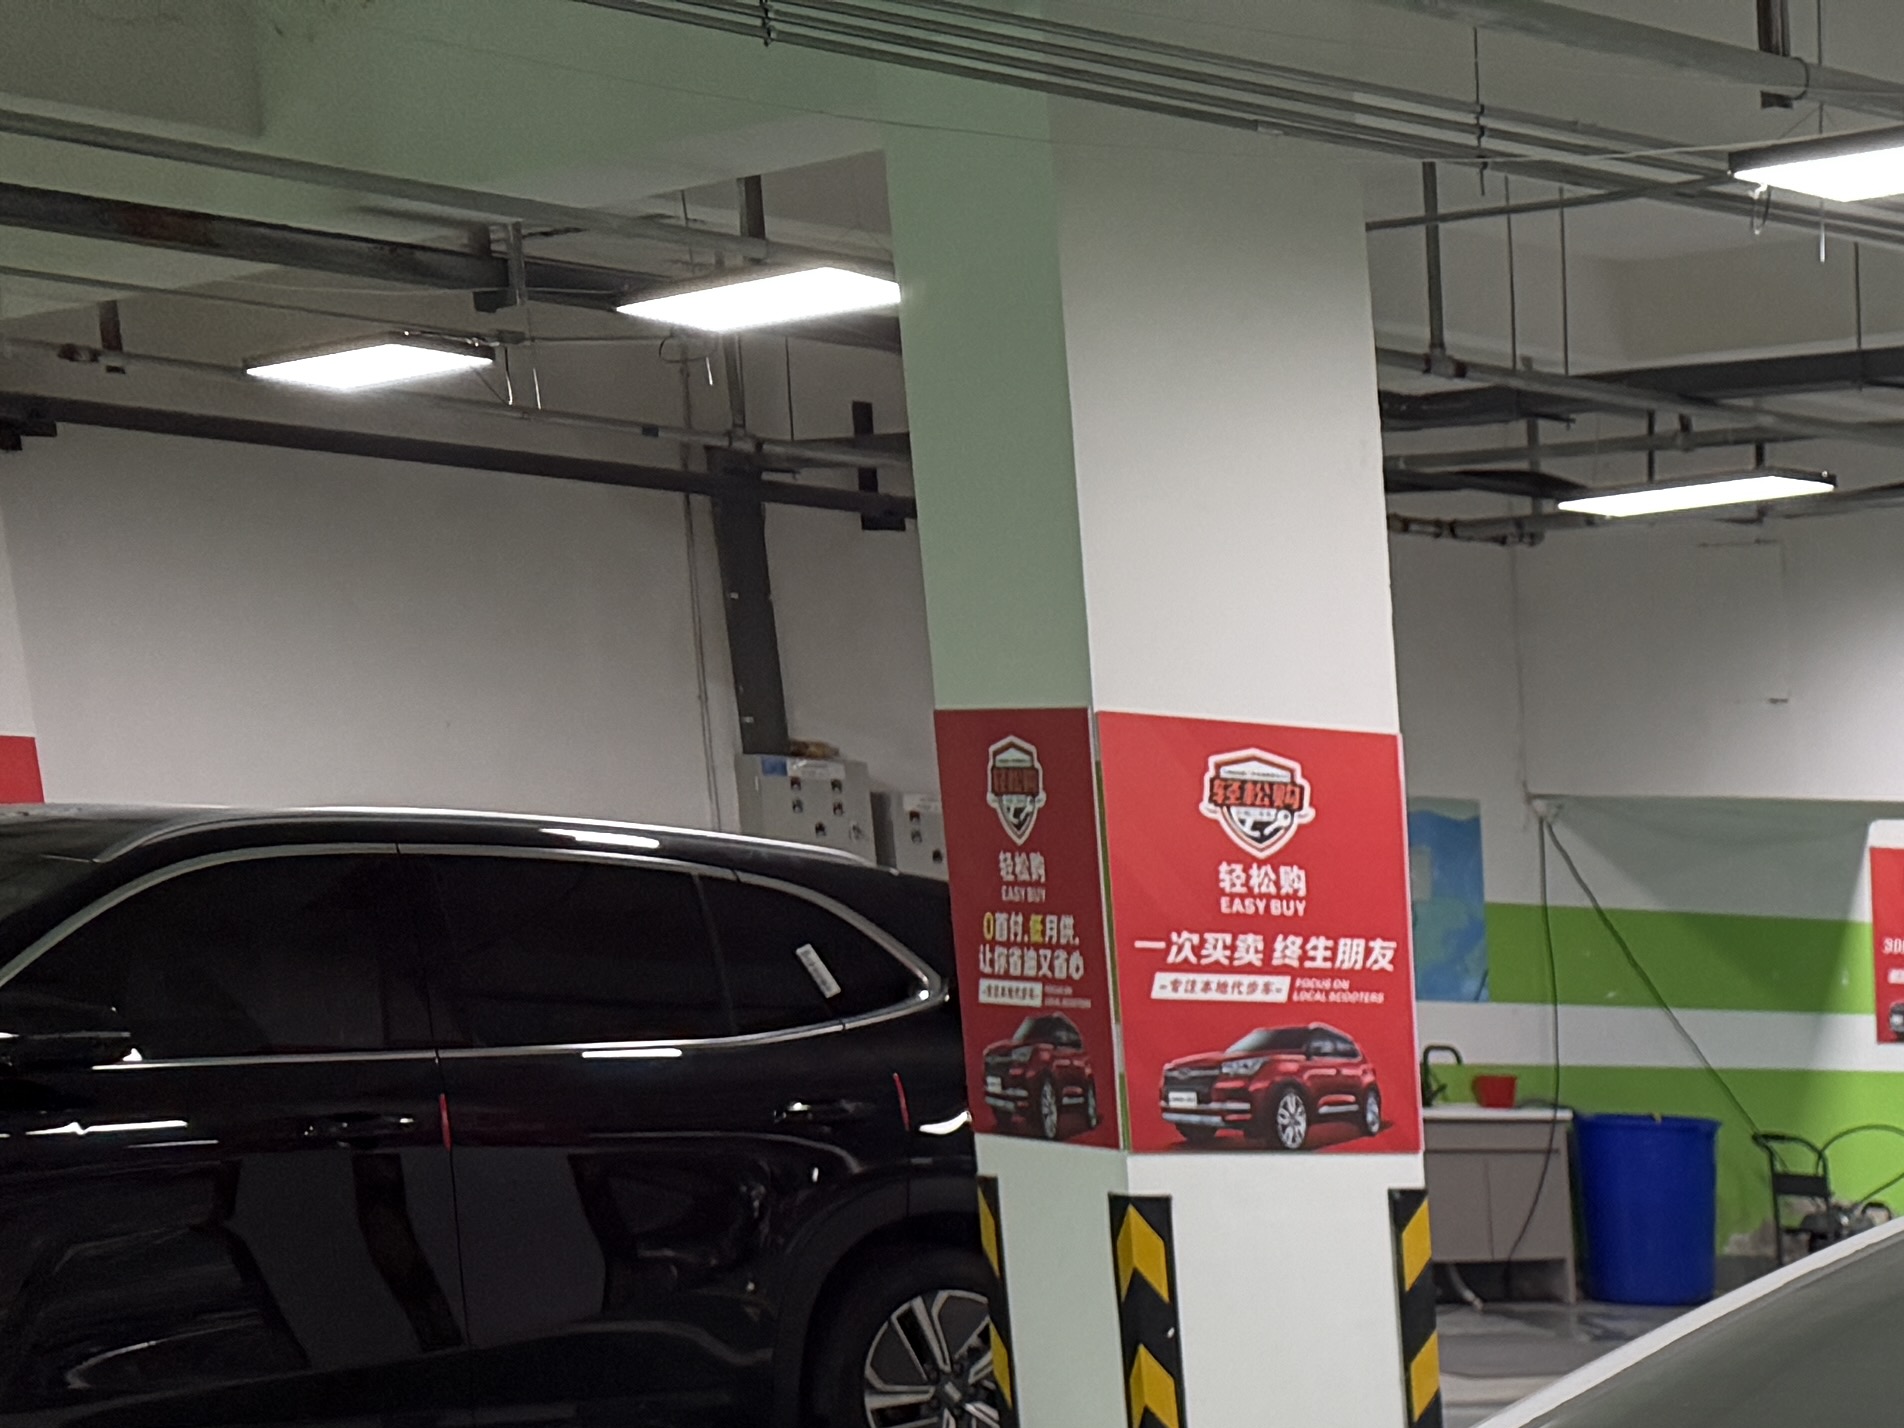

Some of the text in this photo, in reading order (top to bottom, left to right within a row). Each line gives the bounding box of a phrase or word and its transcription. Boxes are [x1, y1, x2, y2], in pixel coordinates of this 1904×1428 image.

[1218, 861, 1308, 898] 轻松购
[1220, 896, 1307, 917] EASY BUY
[1134, 930, 1398, 972] 一次买卖 终生朋友
